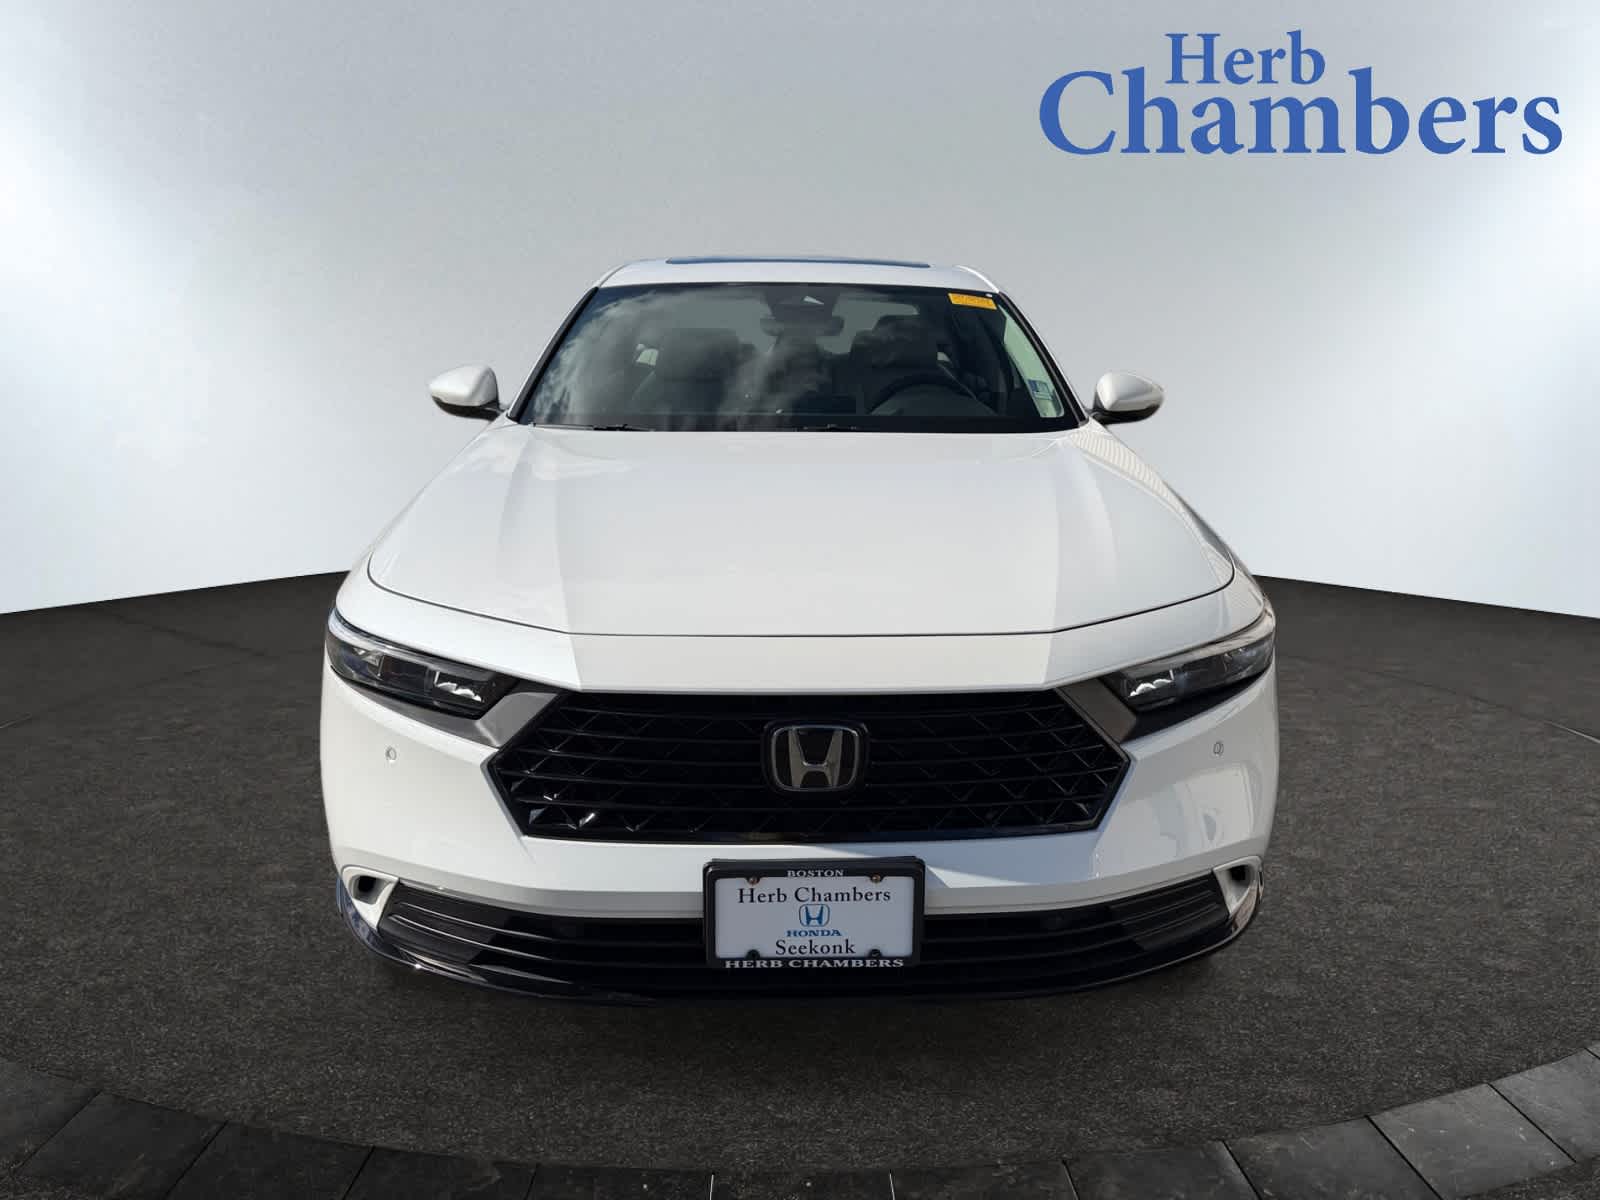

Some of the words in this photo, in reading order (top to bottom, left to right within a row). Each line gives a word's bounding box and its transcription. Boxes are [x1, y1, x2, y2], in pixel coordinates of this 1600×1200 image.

[787, 869, 844, 878] BOSTON
[738, 888, 787, 903] Herb
[794, 886, 891, 903] Chambers
[786, 929, 842, 937] HONDA
[775, 939, 856, 955] Seekonk
[725, 959, 783, 968] HERB
[788, 958, 905, 968] CHAMBERS
